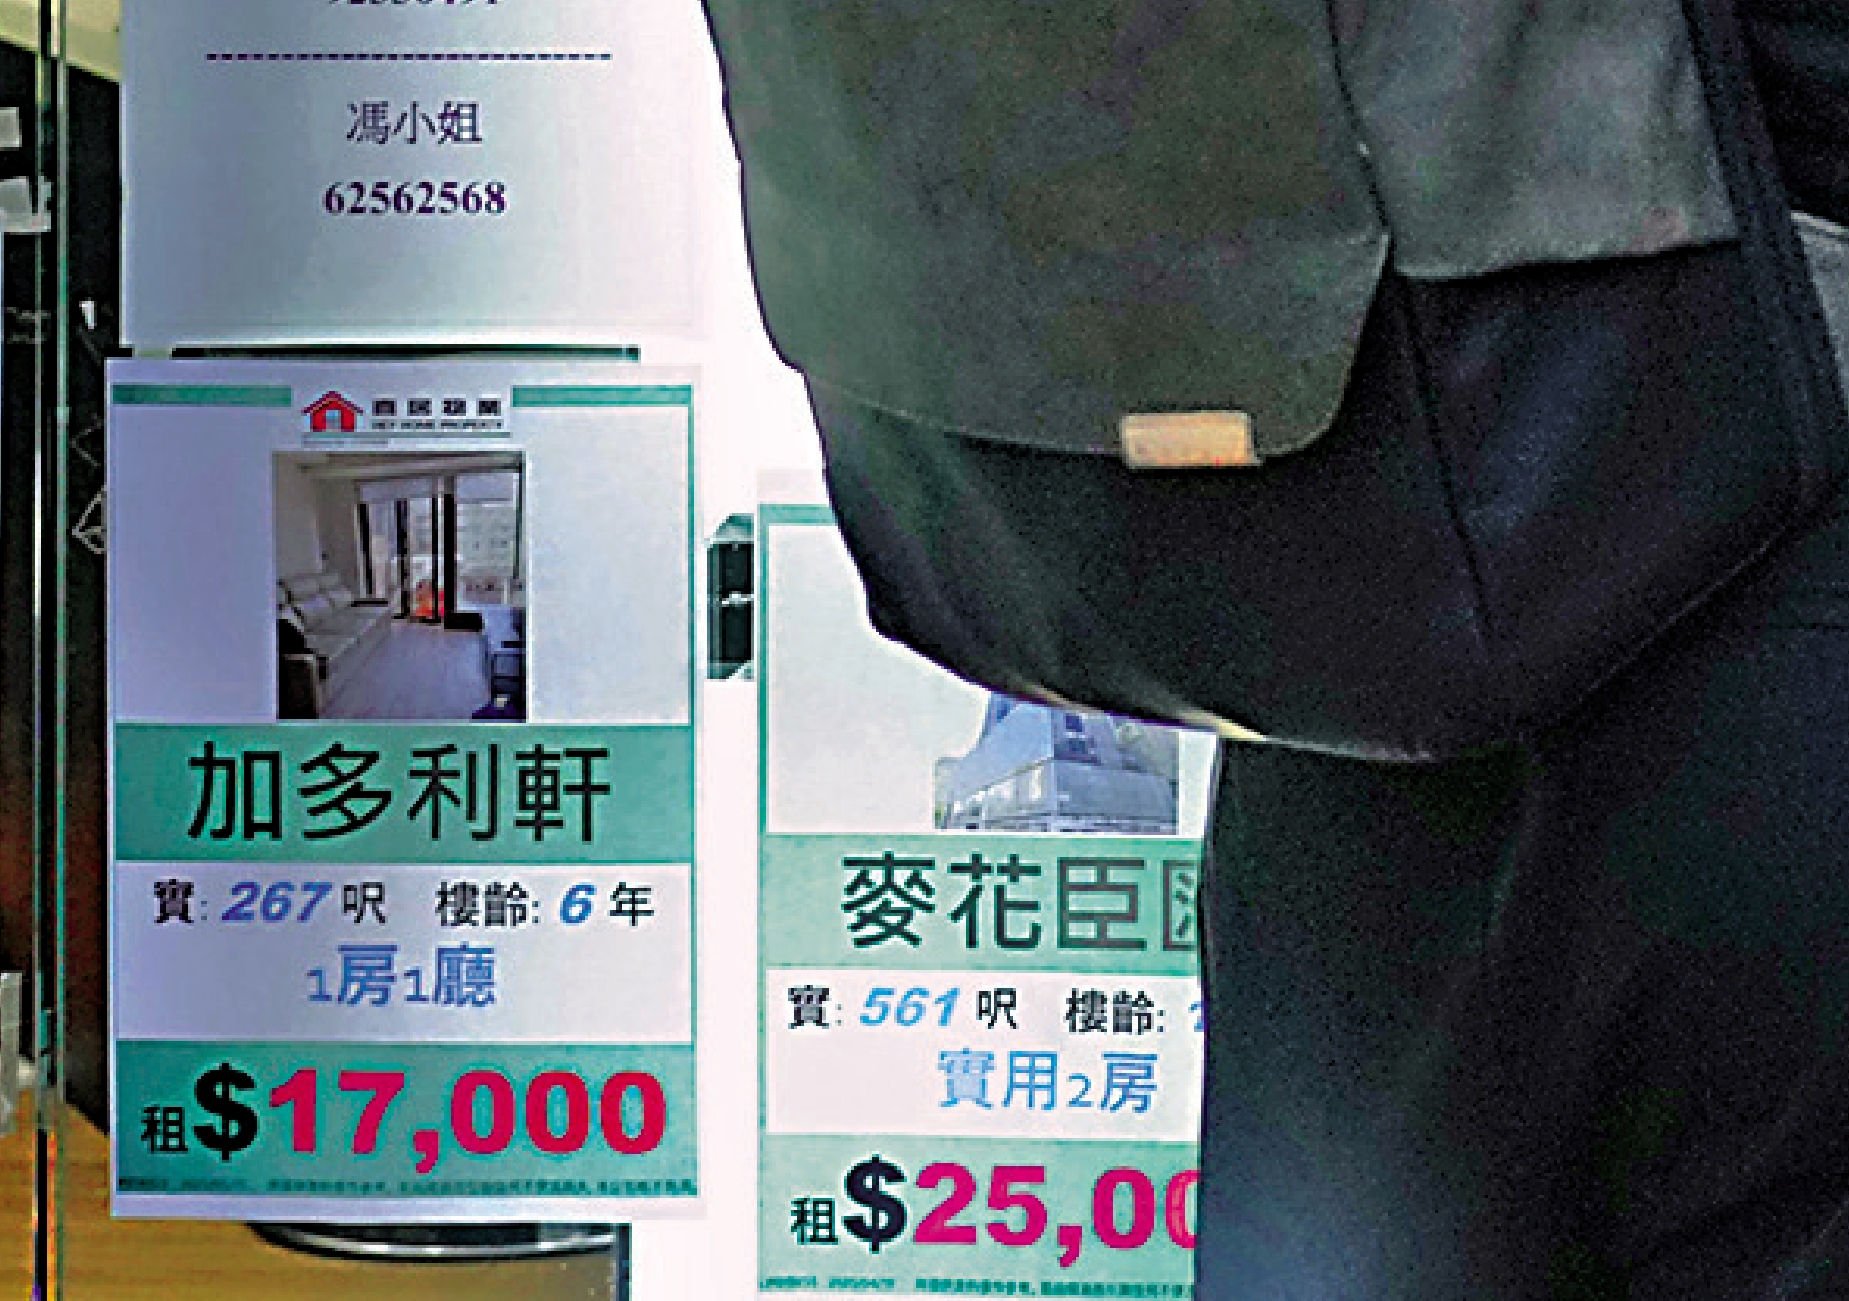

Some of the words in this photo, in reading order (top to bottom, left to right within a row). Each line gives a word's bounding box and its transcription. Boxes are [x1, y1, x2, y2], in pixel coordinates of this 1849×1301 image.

[346, 102, 483, 145] 馮小姐
[323, 182, 507, 216] 62562568
[188, 741, 611, 844] 加多利軒
[220, 883, 330, 923] 267
[341, 886, 388, 924] 呎
[558, 883, 594, 924] 6
[609, 883, 655, 927] 年
[859, 986, 961, 1026] 561
